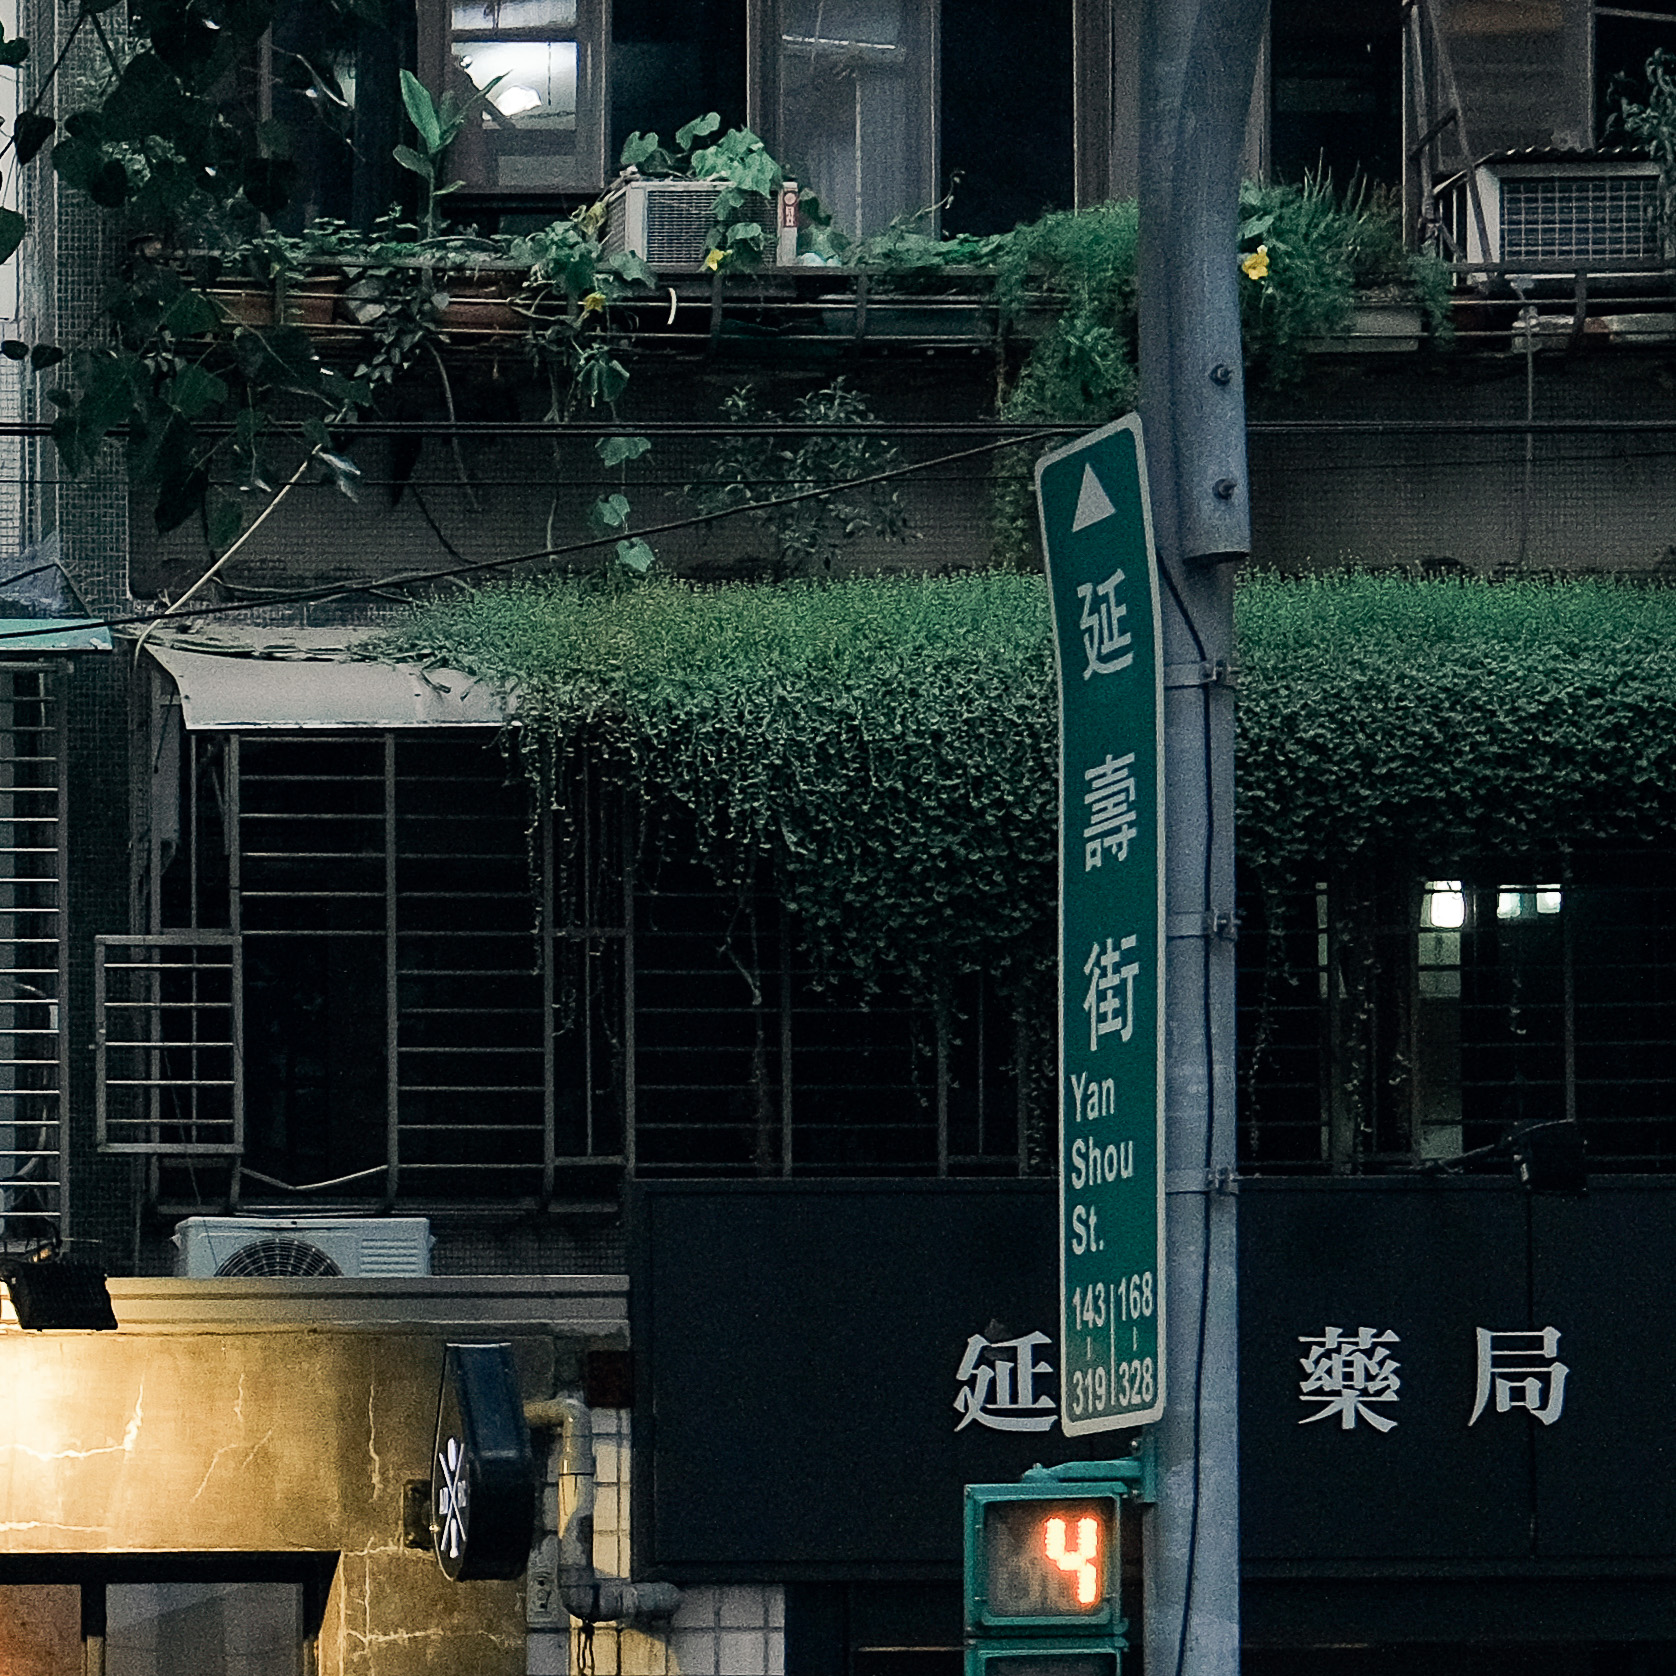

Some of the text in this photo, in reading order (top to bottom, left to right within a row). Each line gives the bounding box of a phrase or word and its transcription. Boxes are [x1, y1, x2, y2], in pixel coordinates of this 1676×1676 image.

[1077, 568, 1139, 1051] 延壽街
[1071, 1071, 1115, 1122] Yan
[1071, 1137, 1134, 1190] Shou
[1071, 1205, 1105, 1255] St.
[1072, 1282, 1106, 1331] 143
[1118, 1271, 1153, 1322] 168
[1072, 1367, 1106, 1415] 319
[1118, 1357, 1154, 1407] 328
[1043, 1515, 1099, 1605] 4
